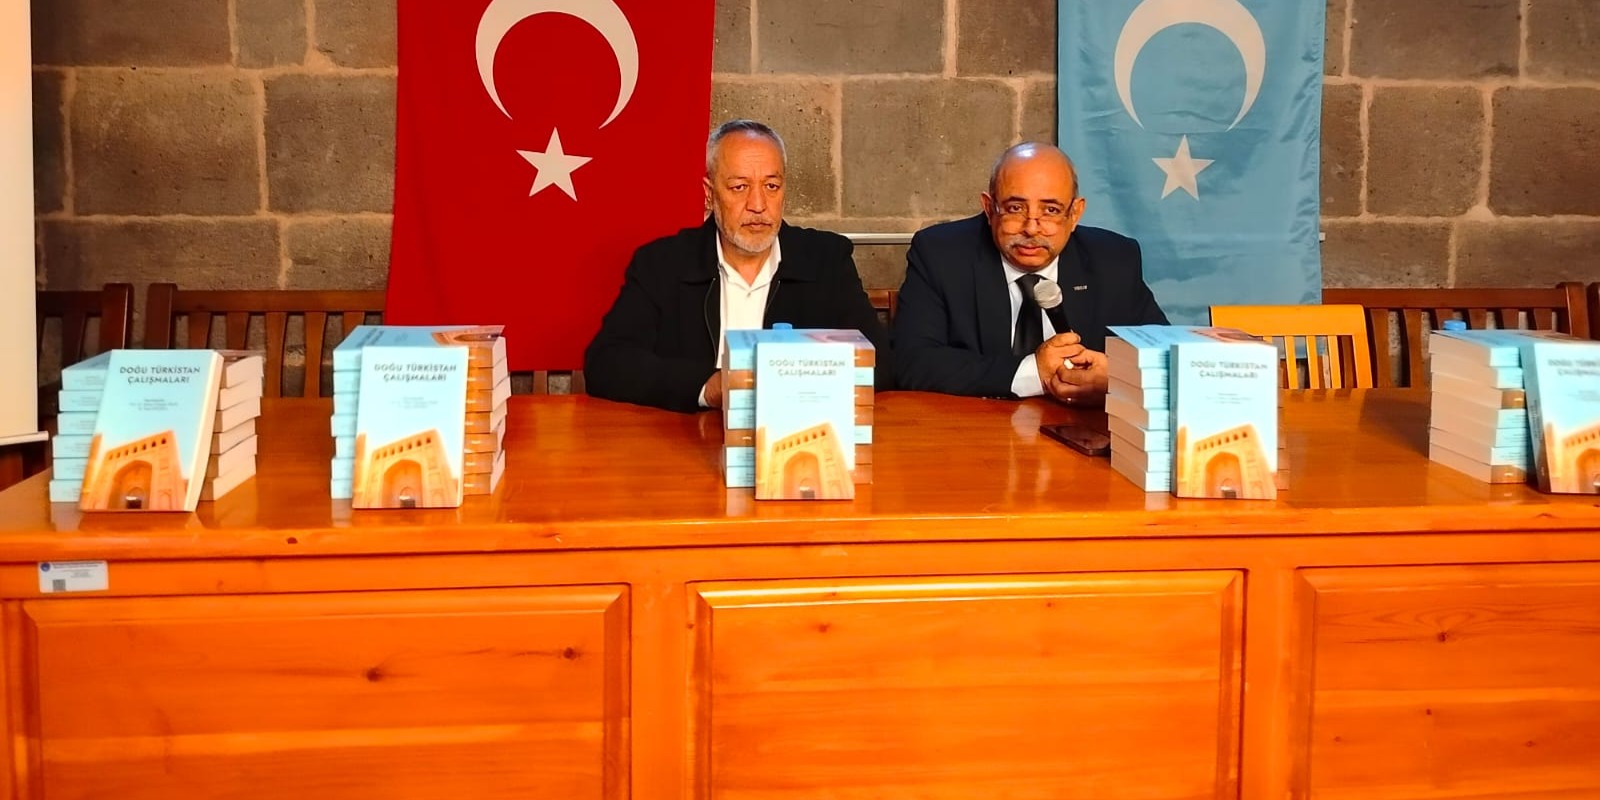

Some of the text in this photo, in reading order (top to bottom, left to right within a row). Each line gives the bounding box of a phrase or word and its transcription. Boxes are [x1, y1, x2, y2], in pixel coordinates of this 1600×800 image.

[769, 357, 796, 367] DOĞU
[119, 364, 201, 374] DOĞU TÜRKİSTAN
[374, 362, 457, 373] DOĞU TÜRKİSTAN
[127, 376, 190, 386] ÇALIŞMALARI
[383, 373, 448, 383] ÇALIŞMALARI
